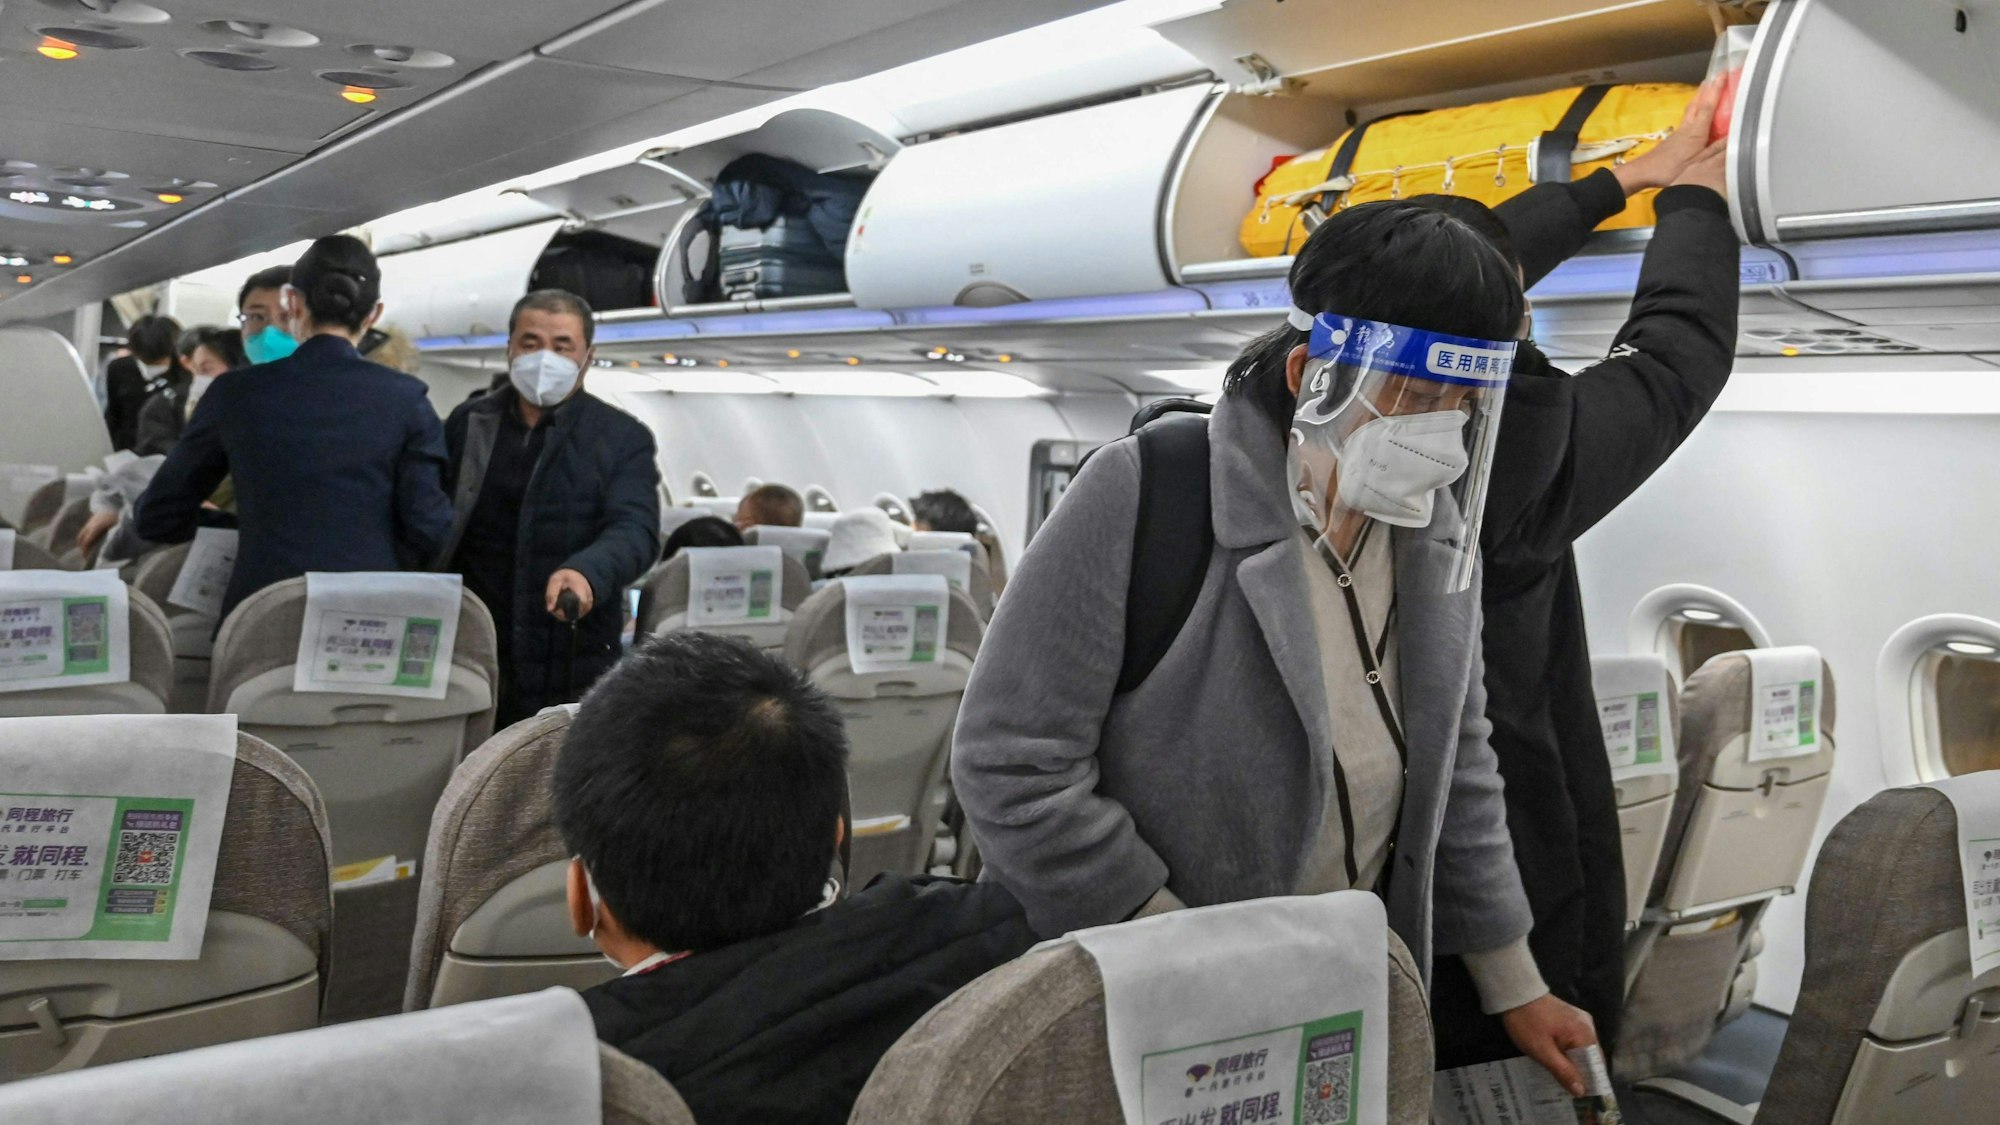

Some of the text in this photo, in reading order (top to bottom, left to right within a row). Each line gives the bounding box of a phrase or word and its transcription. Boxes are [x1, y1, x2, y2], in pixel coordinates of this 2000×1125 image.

[6, 807, 75, 823] 同程旅行
[1213, 1047, 1269, 1078] 同程旅行
